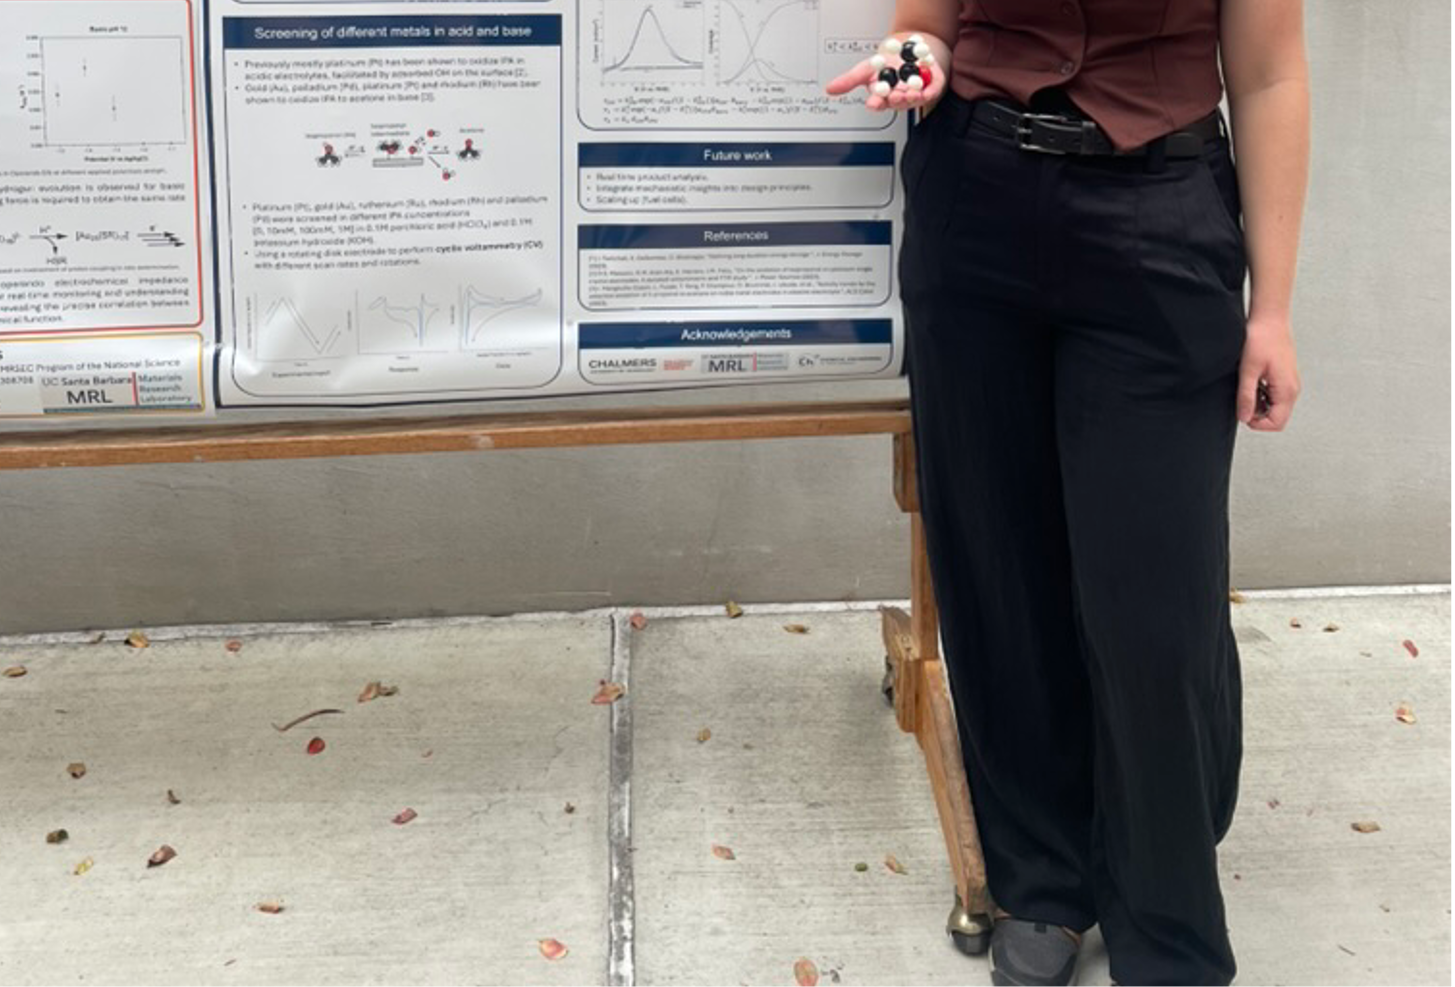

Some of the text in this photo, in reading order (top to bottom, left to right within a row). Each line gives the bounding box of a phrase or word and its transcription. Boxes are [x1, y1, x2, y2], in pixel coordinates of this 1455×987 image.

[254, 25, 531, 42] Screening of different metals in acid and base
[703, 149, 771, 160] Future work
[703, 229, 768, 241] References
[434, 240, 543, 254] cyclic voltammetry (CV)
[680, 327, 791, 343] Acknowledgements
[35, 360, 74, 373] Program
[86, 359, 101, 369] the
[102, 358, 142, 368] National
[144, 357, 180, 367] Science
[588, 357, 656, 369] CHALMERS
[708, 359, 746, 373] MRL
[41, 375, 134, 386] UC Santa Barbara
[136, 374, 182, 383] Materials
[138, 383, 181, 393] Research
[67, 390, 113, 404] MRL
[139, 393, 192, 405] Laboratory
